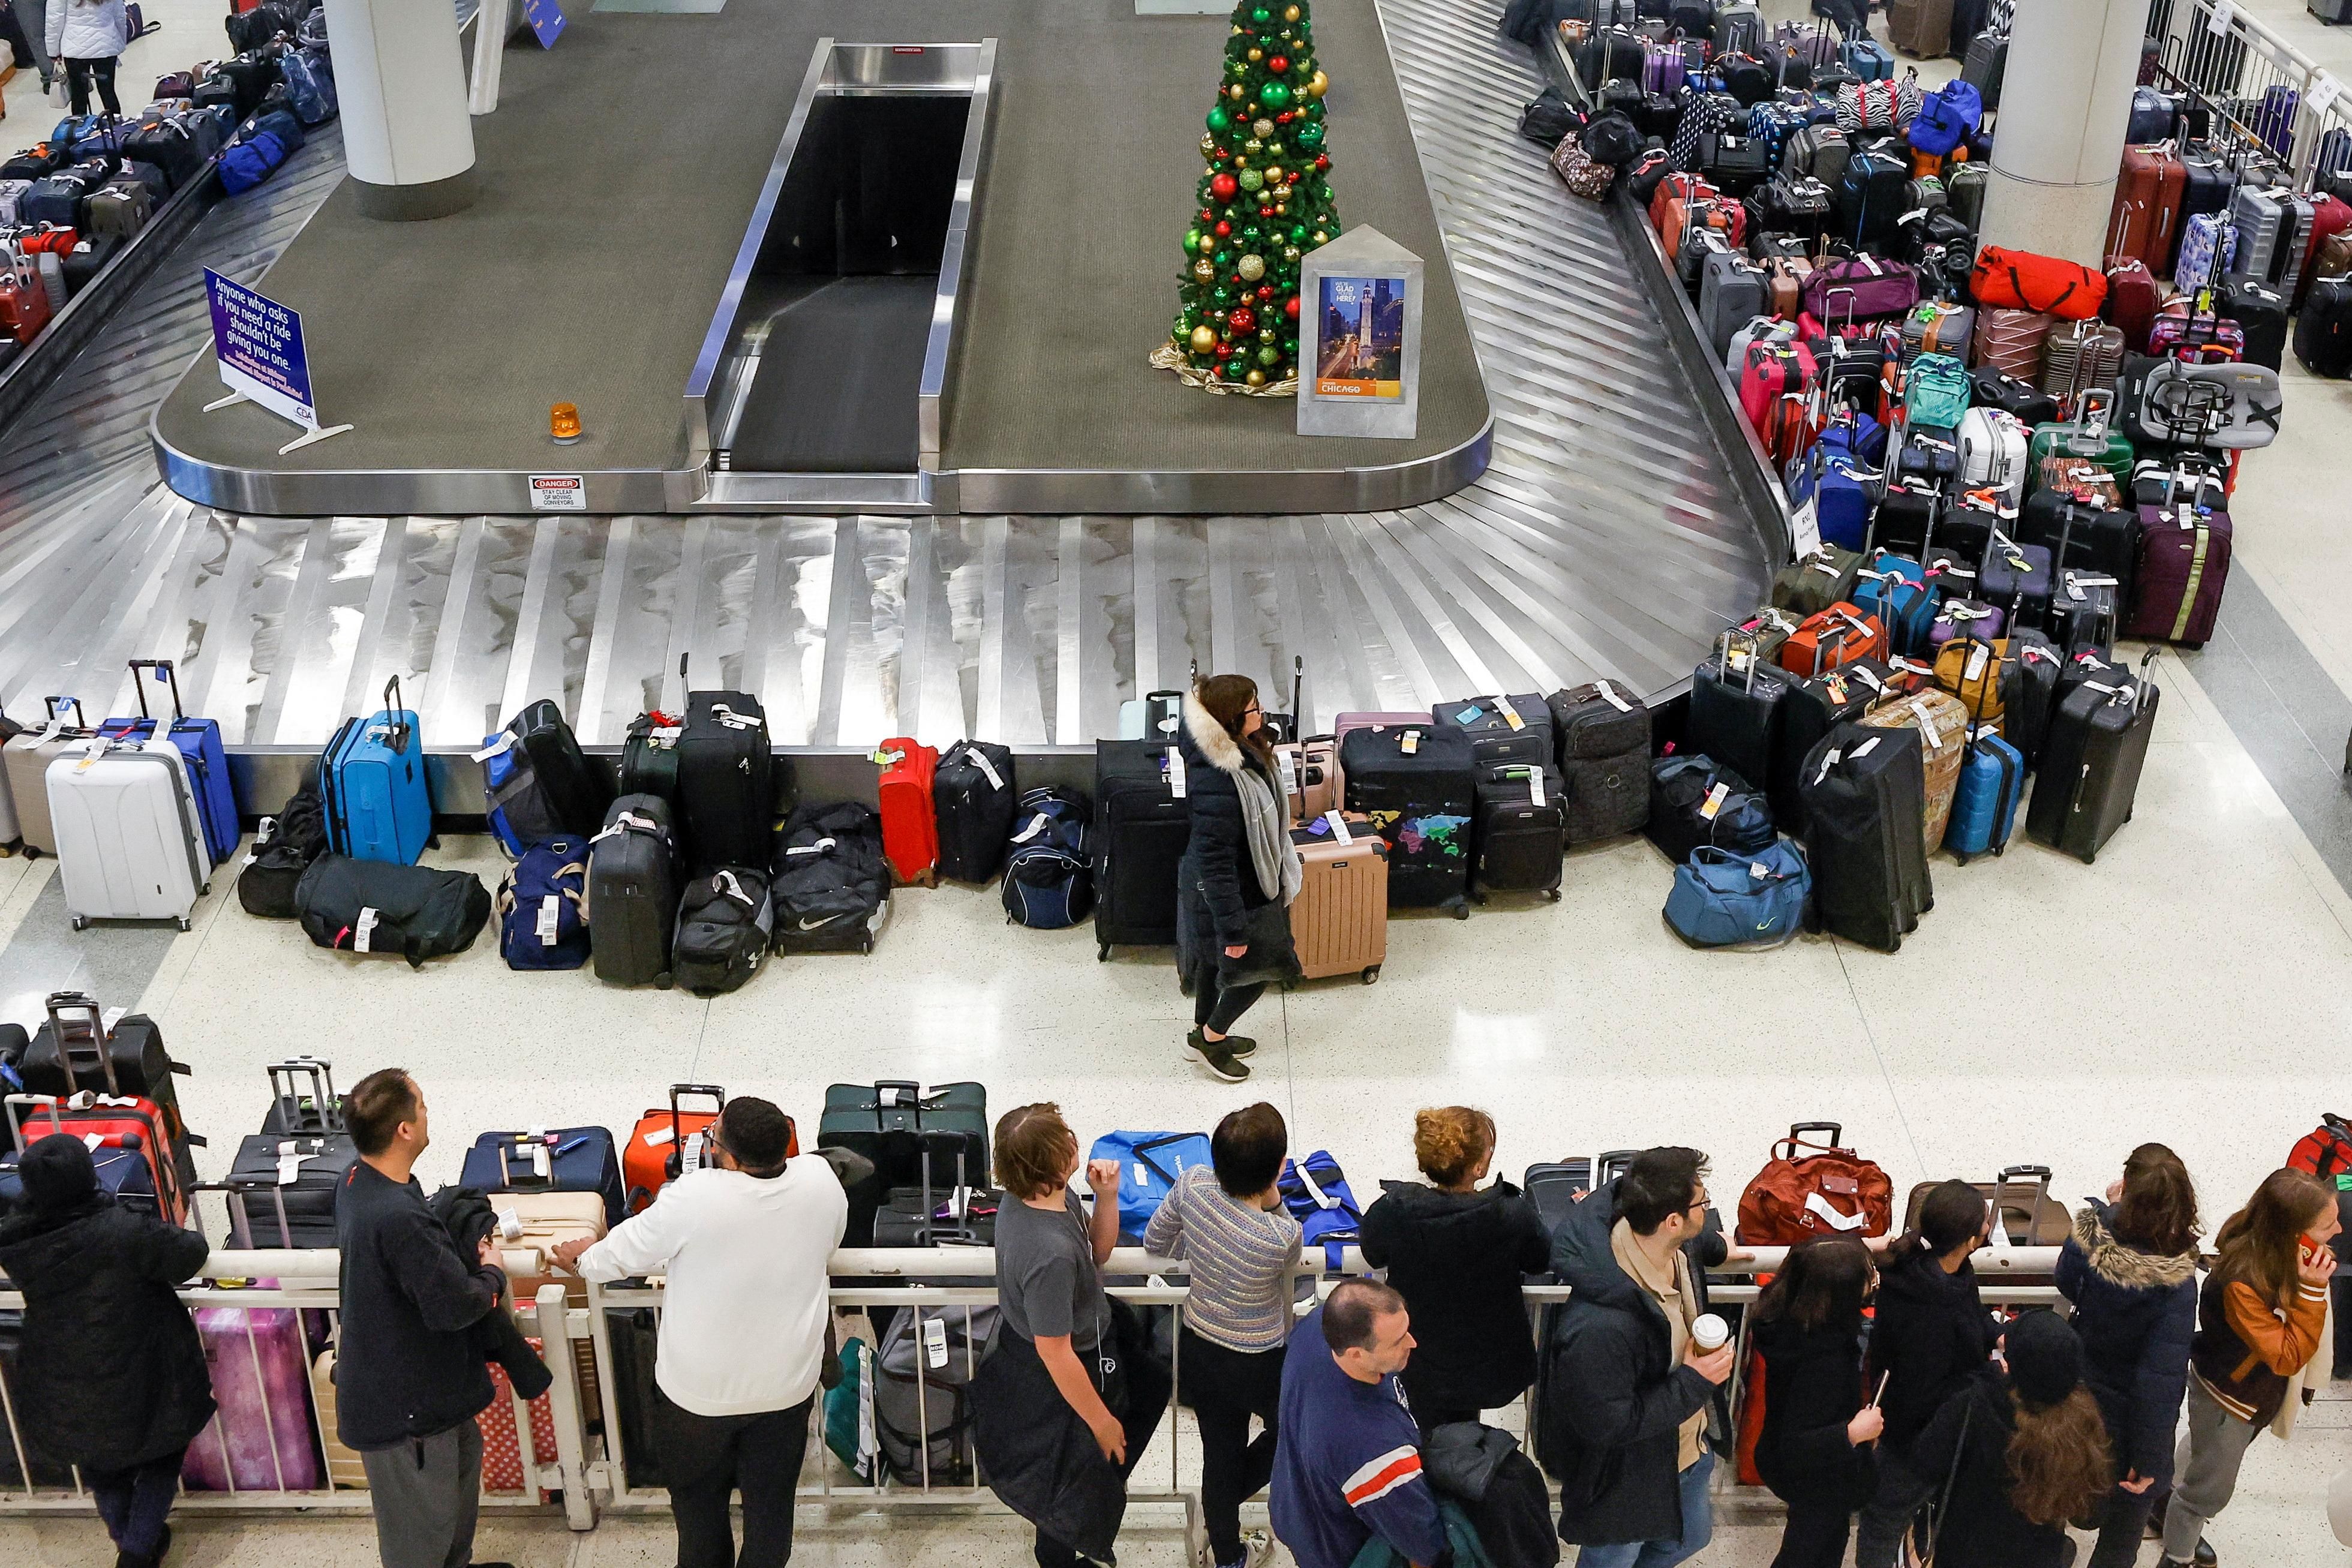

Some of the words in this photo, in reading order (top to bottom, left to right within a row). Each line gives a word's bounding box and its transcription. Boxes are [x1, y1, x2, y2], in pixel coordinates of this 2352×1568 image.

[215, 278, 246, 304] Anyone
[247, 296, 266, 314] who
[268, 307, 289, 325] asks
[217, 292, 223, 307] if
[224, 299, 240, 316] you
[242, 308, 263, 328] need
[265, 321, 271, 332] a
[274, 322, 291, 341] ride
[1336, 295, 1356, 305] HERE!
[227, 329, 252, 355] giving
[253, 343, 269, 361] you
[271, 353, 292, 371] one.
[230, 315, 269, 346] shouldn't
[270, 334, 282, 352] be
[1321, 385, 1361, 393] CHICAGO
[296, 407, 313, 422] CDA
